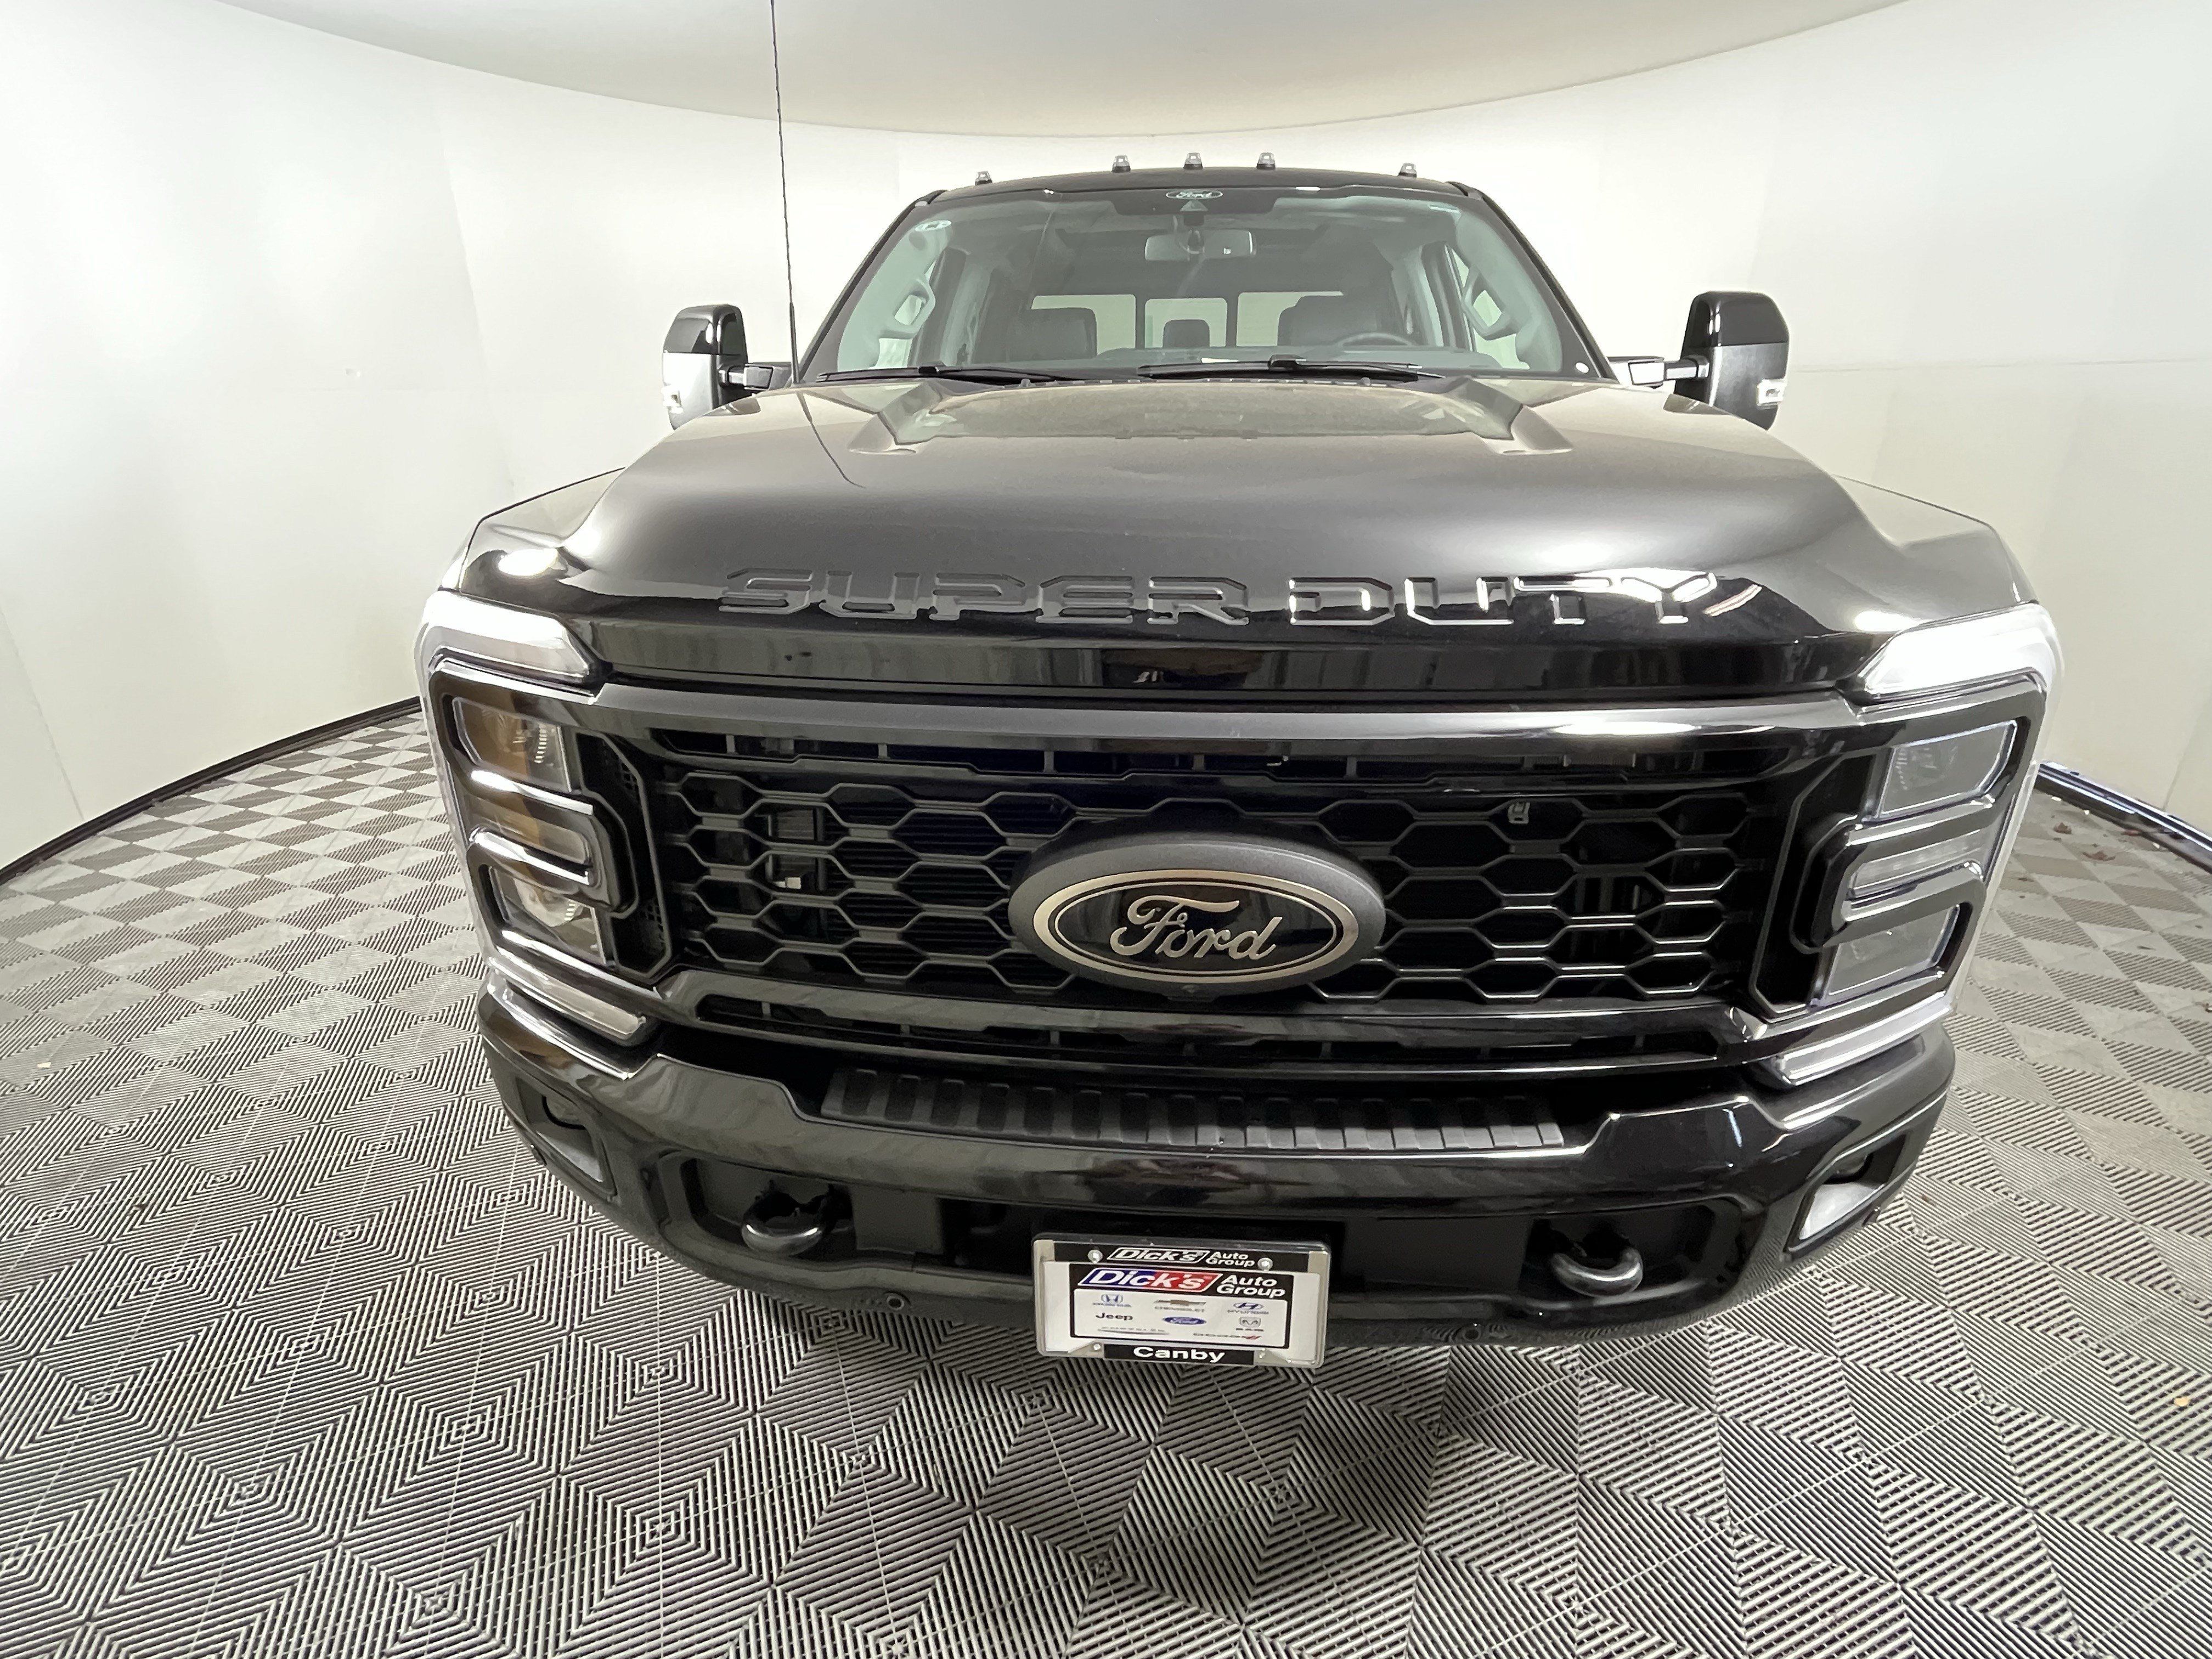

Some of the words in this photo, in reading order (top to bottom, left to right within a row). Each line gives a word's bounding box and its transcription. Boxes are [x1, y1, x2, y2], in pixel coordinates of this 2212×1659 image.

[719, 568, 1249, 625] SUPER
[1288, 567, 1719, 625] DUTY
[1109, 895, 1283, 961] Ford
[1206, 1257, 1255, 1268] Group
[1210, 1251, 1249, 1260] Auto
[1089, 1269, 1205, 1290] Dick's
[1221, 1274, 1278, 1287] Auto
[1216, 1284, 1286, 1299] Group
[1096, 1312, 1133, 1321] Jeep
[1133, 1346, 1226, 1363] Canby
